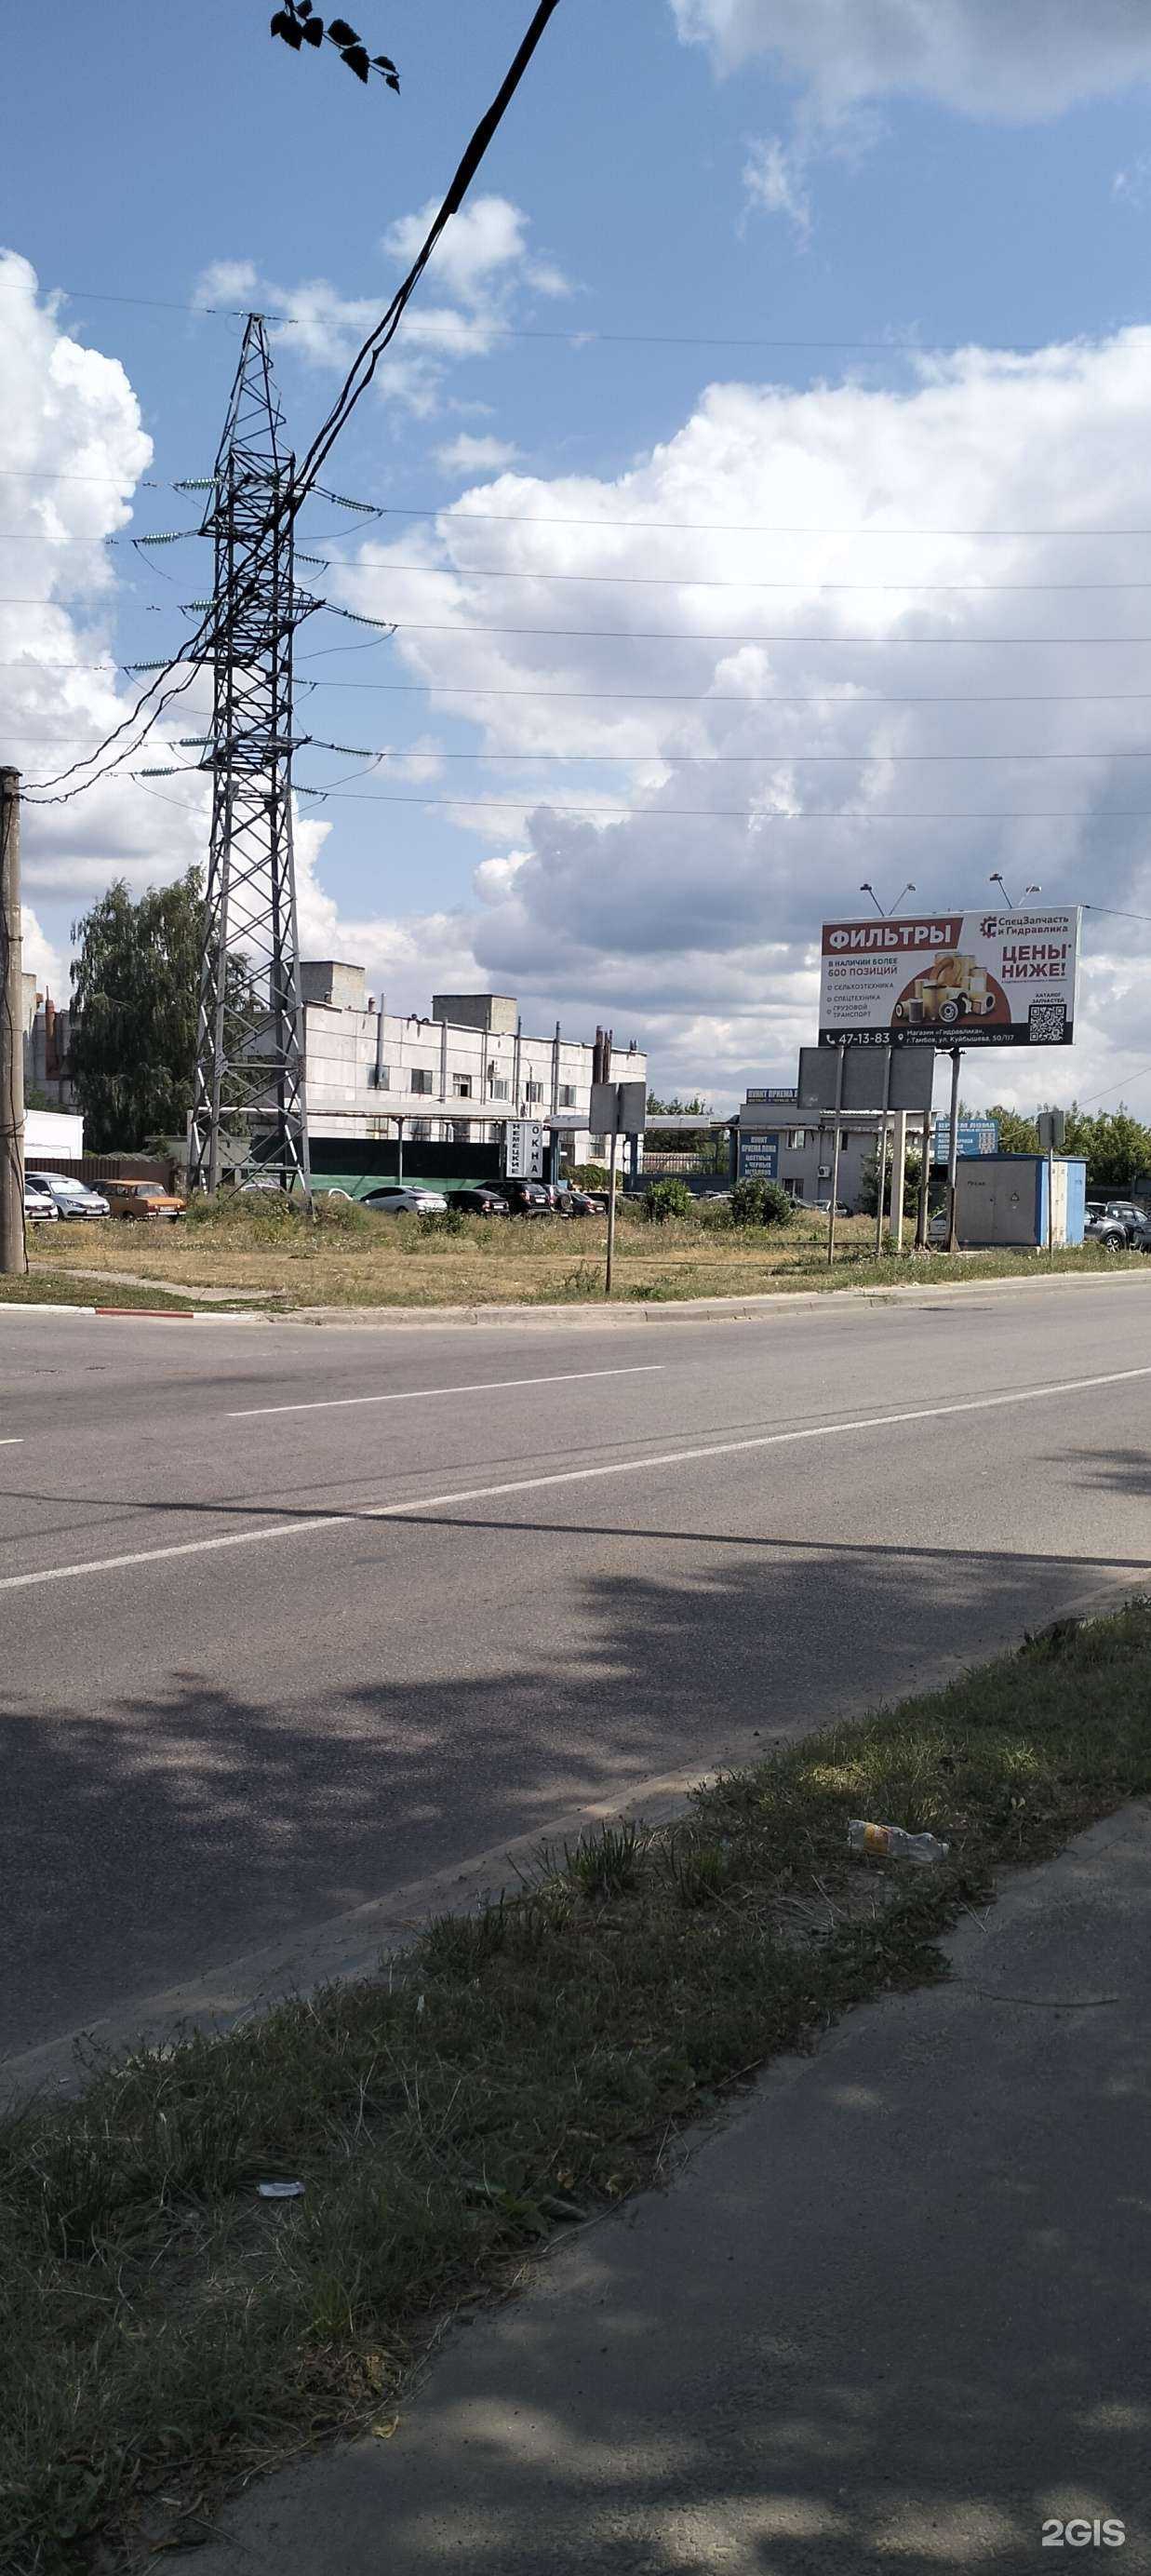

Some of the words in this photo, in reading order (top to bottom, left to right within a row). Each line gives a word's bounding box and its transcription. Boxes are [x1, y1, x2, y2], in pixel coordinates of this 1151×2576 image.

[997, 916, 1069, 927] СпецЗапчасть
[829, 924, 952, 949] ФИЛЬТРЫ
[1006, 925, 1068, 936] Гидравлика
[835, 959, 871, 967] НАЛИЧИИ
[872, 958, 898, 966] БОЛЕЕ
[828, 969, 847, 977] 600
[849, 964, 898, 976] ПОЗИЦИЙ
[1001, 963, 1066, 978] НИЖЕ!
[838, 1032, 890, 1045] 47-13-83
[531, 1126, 540, 1173] ОКНА
